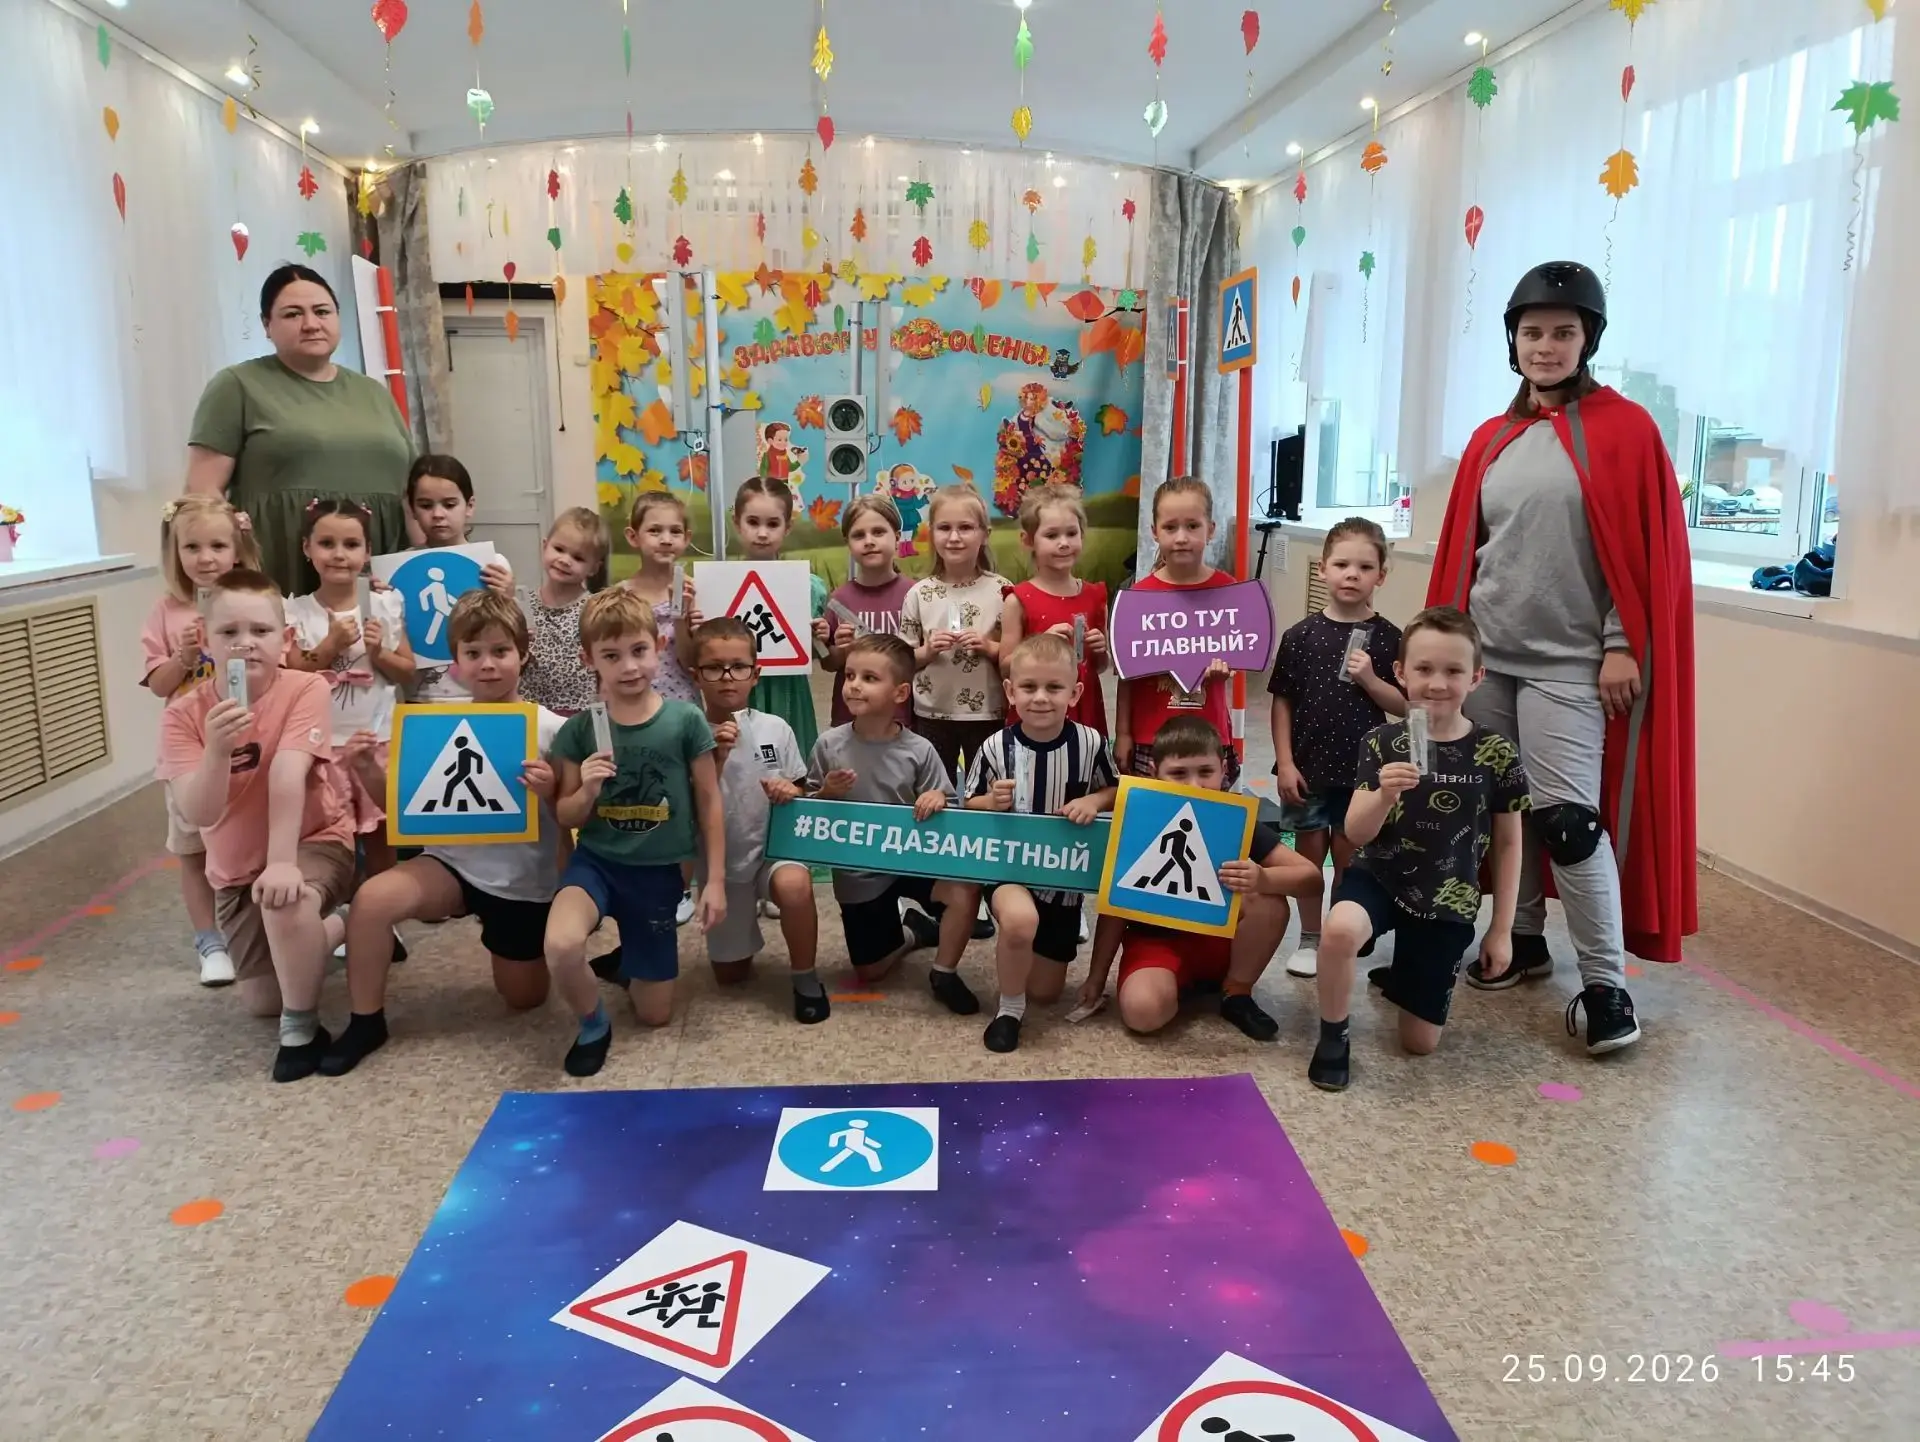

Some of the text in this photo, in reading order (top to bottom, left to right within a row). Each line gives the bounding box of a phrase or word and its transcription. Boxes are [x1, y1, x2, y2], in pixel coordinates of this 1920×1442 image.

[1141, 608, 1239, 632] КТО ТУТ
[1131, 629, 1259, 658] ГЛАВНЫЙ?
[1415, 820, 1441, 831] STYLE
[793, 814, 1090, 873] #ВСЕГДАЗАМЕТНЫЙ
